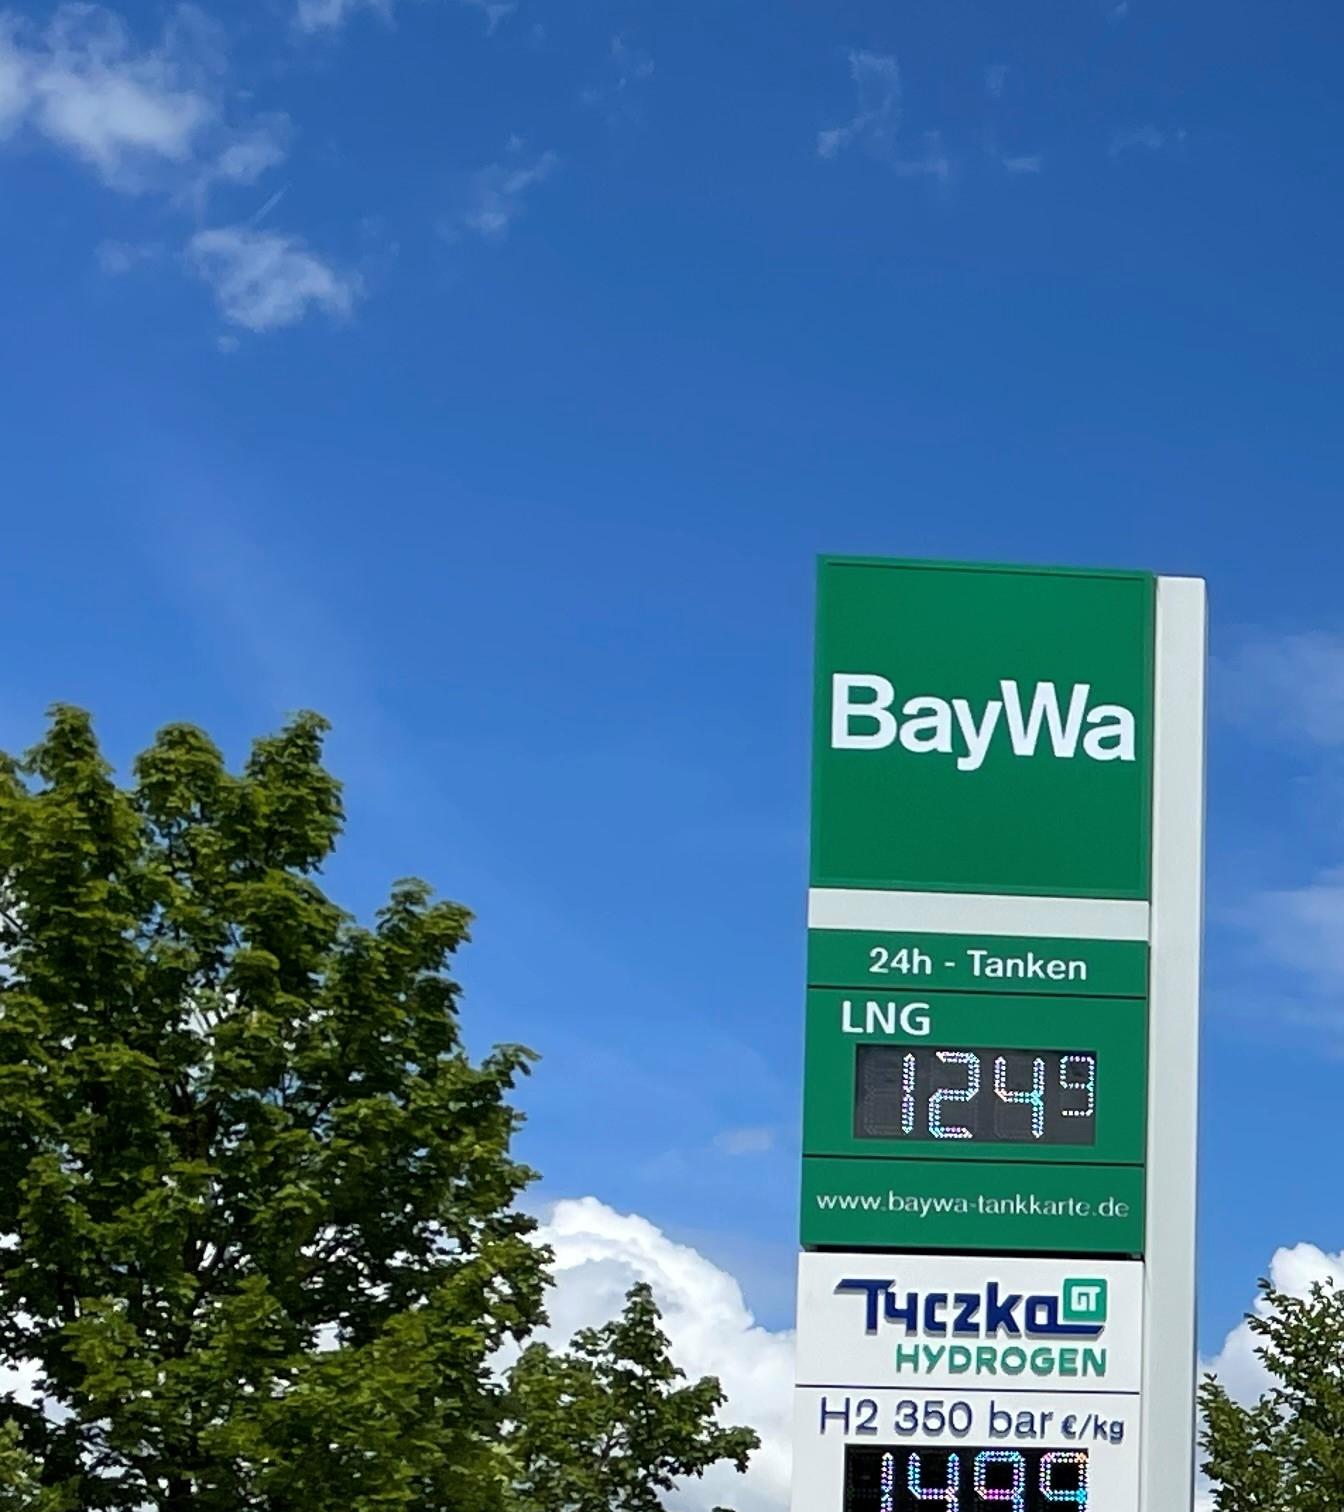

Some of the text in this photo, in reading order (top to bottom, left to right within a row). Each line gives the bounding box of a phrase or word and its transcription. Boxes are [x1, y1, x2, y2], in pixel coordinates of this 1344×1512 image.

[830, 672, 1136, 771] BayWa
[868, 947, 932, 975] 24h
[966, 949, 1088, 981] Tanken
[841, 1000, 931, 1036] LNG
[816, 1190, 1130, 1218] www.baywa-tankkarte.de
[834, 1278, 1106, 1340] Tyczka
[895, 1343, 1107, 1377] HYDROGEN
[820, 1396, 1125, 1445] H2 350 bar €/kg
